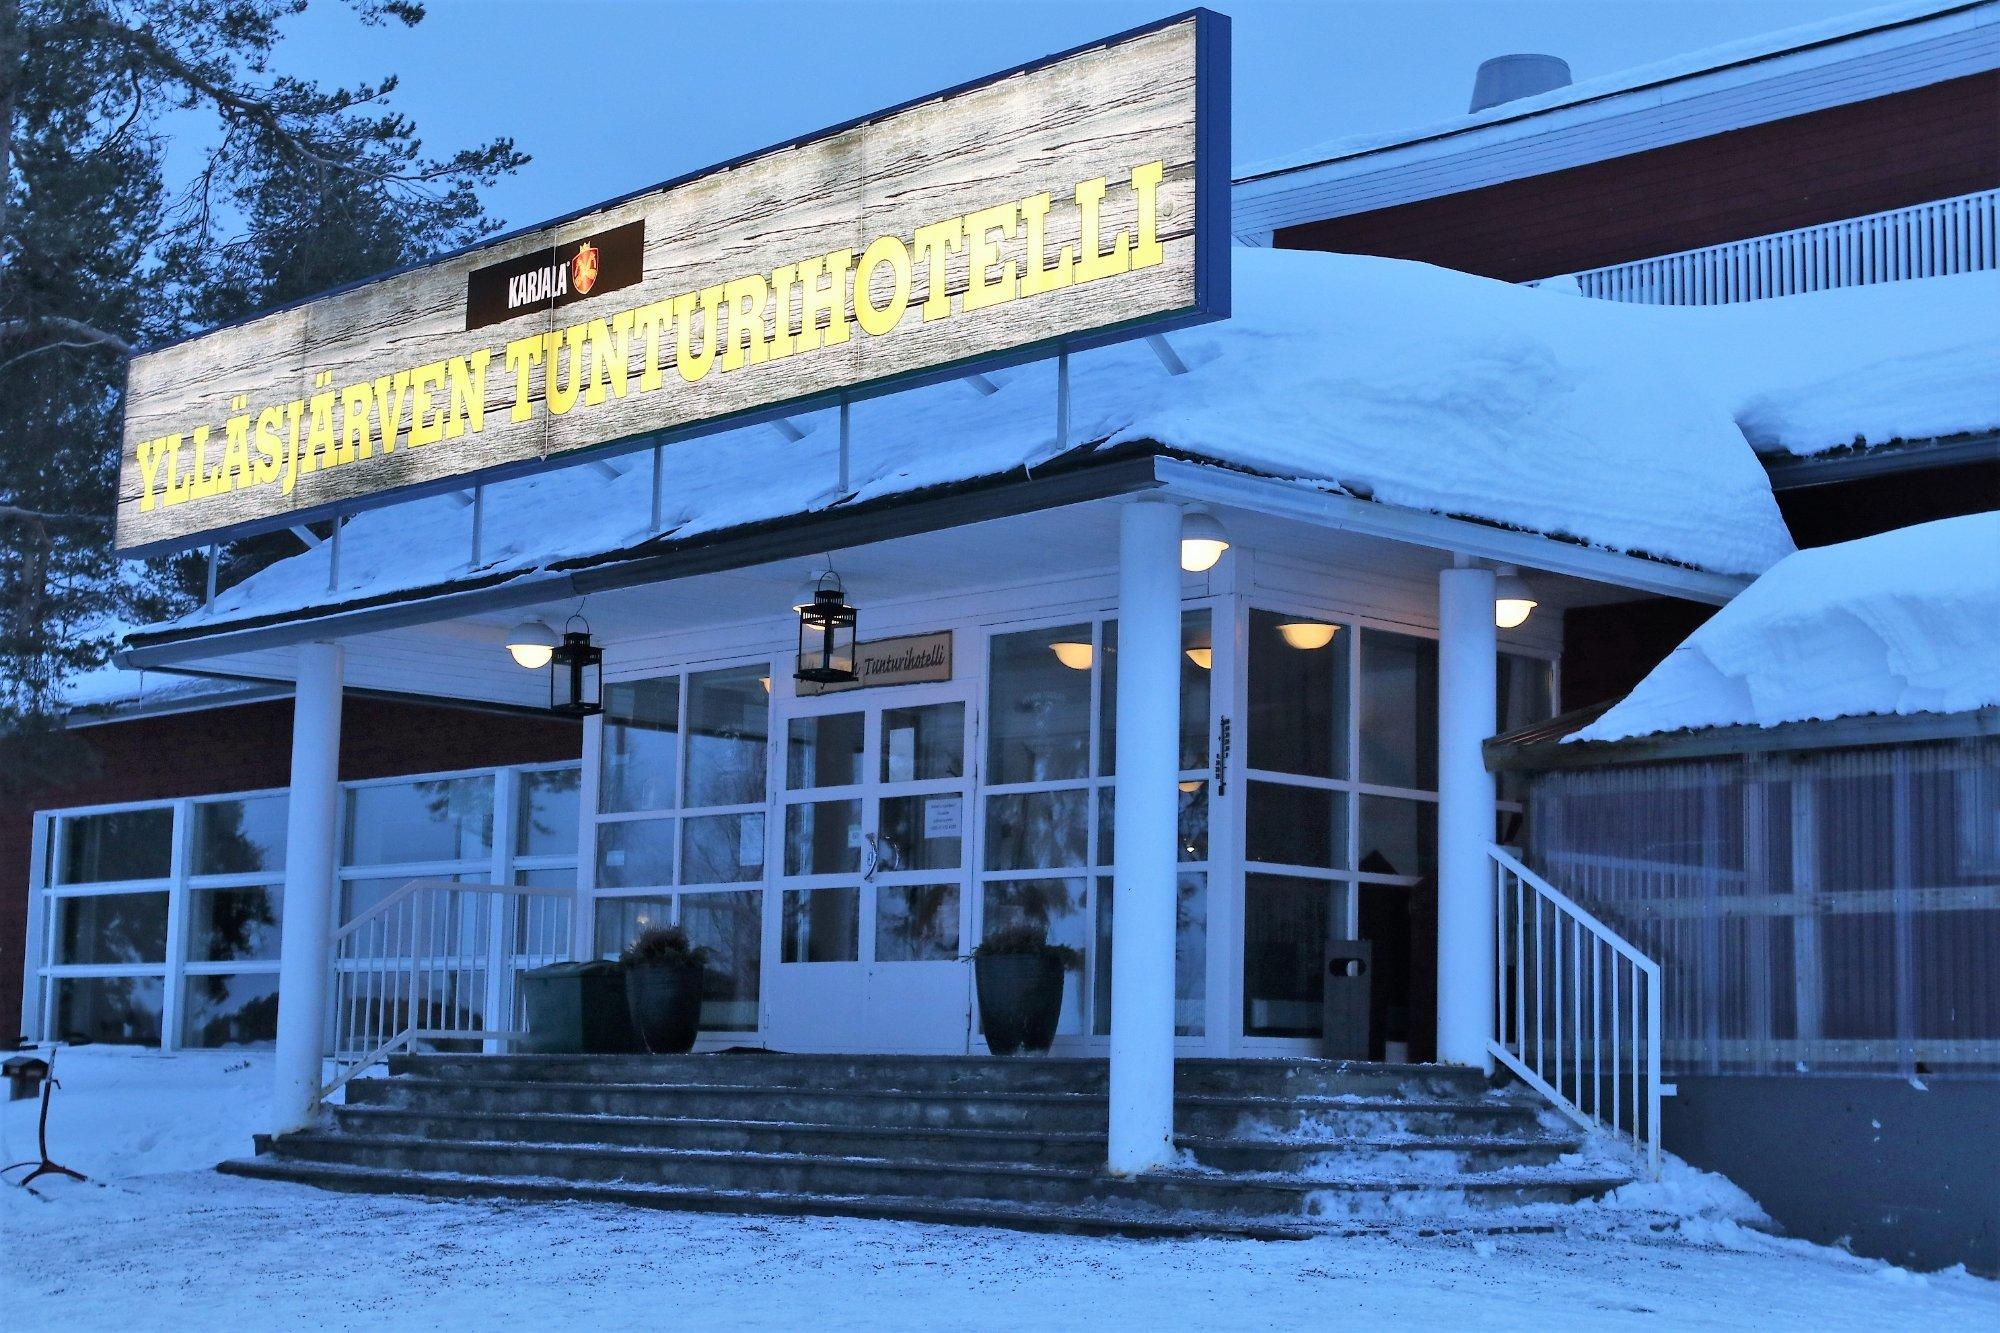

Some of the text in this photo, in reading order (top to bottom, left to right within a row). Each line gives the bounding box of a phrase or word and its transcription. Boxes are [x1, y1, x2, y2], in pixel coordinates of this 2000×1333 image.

[508, 264, 567, 309] KARJALA
[136, 159, 1164, 513] YLLÄSJÄRVEN TUNTURIHOTELLI
[864, 645, 945, 676] Tunturihotelli
